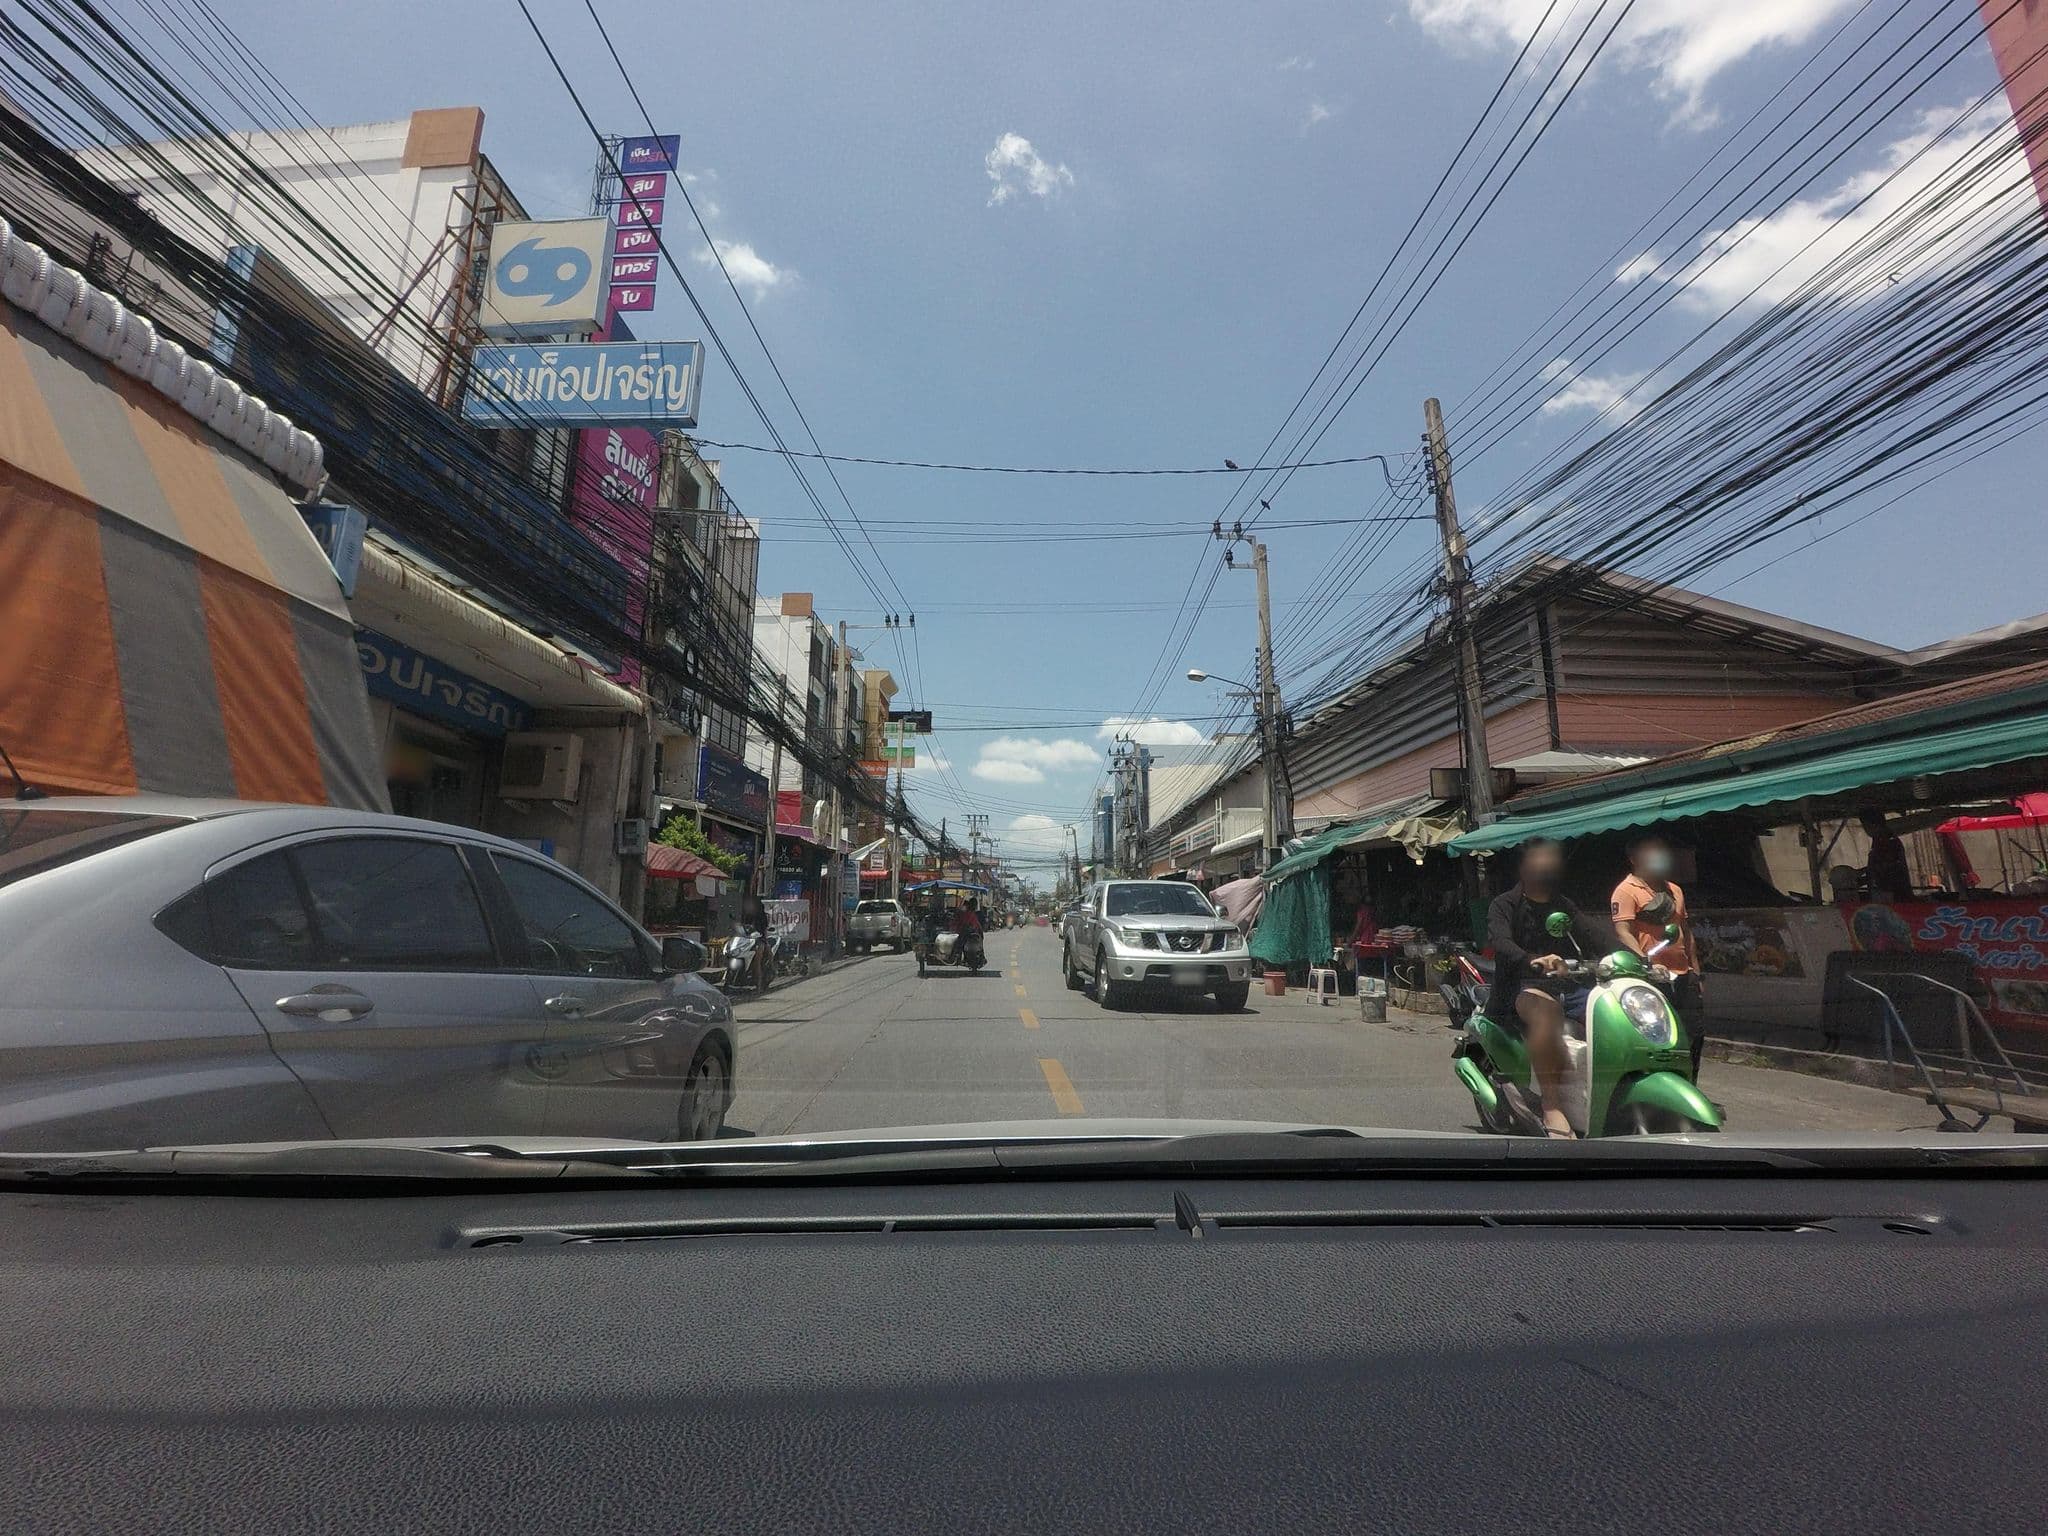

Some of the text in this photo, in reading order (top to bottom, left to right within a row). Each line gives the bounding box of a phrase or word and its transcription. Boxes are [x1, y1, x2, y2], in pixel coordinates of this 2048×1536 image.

[632, 179, 656, 194] สิน
[626, 202, 654, 223] เชื่อ
[623, 232, 652, 249] เงิน
[613, 258, 654, 277] เทอร์
[621, 289, 641, 305] โบ
[604, 427, 653, 488] สินเชื่อ
[358, 642, 524, 731] อปเจริญ
